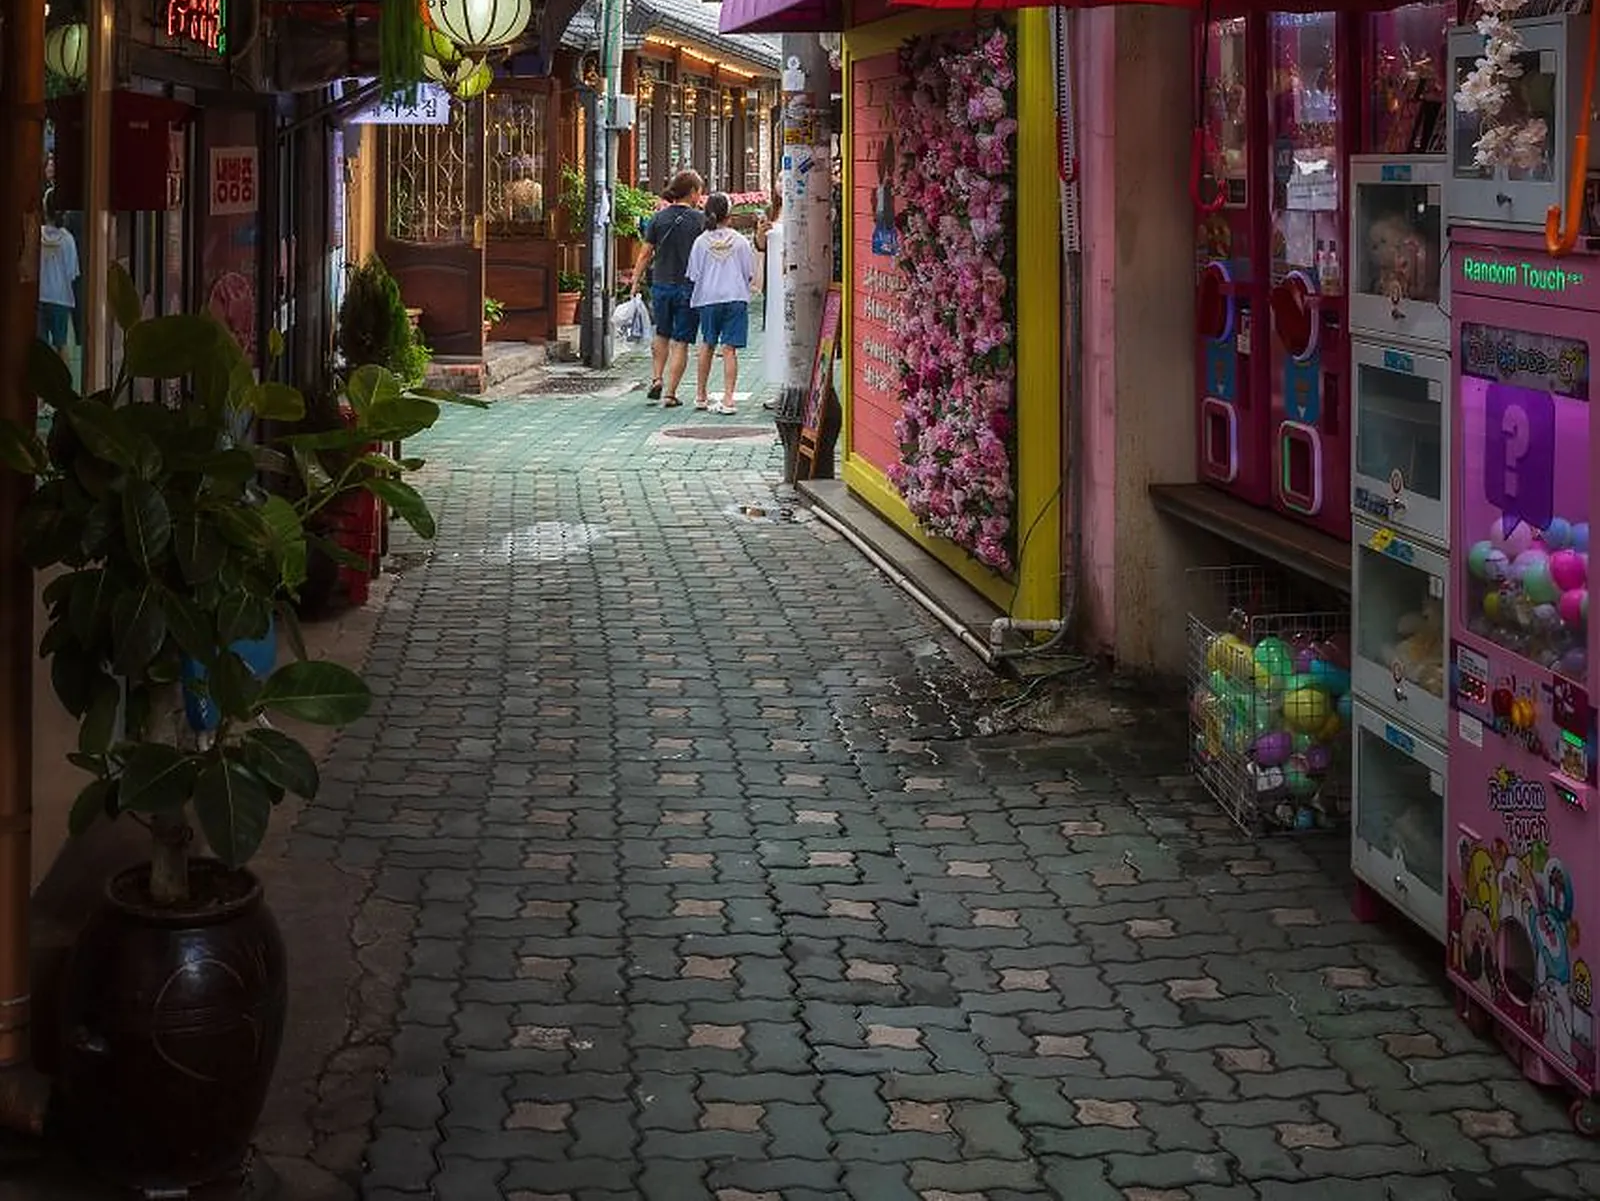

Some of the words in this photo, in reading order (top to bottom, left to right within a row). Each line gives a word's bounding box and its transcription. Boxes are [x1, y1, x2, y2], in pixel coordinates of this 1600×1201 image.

[1463, 257, 1517, 286] Random
[1521, 263, 1565, 292] Touch
[1489, 779, 1545, 810] Random
[1503, 812, 1549, 844] Touch
